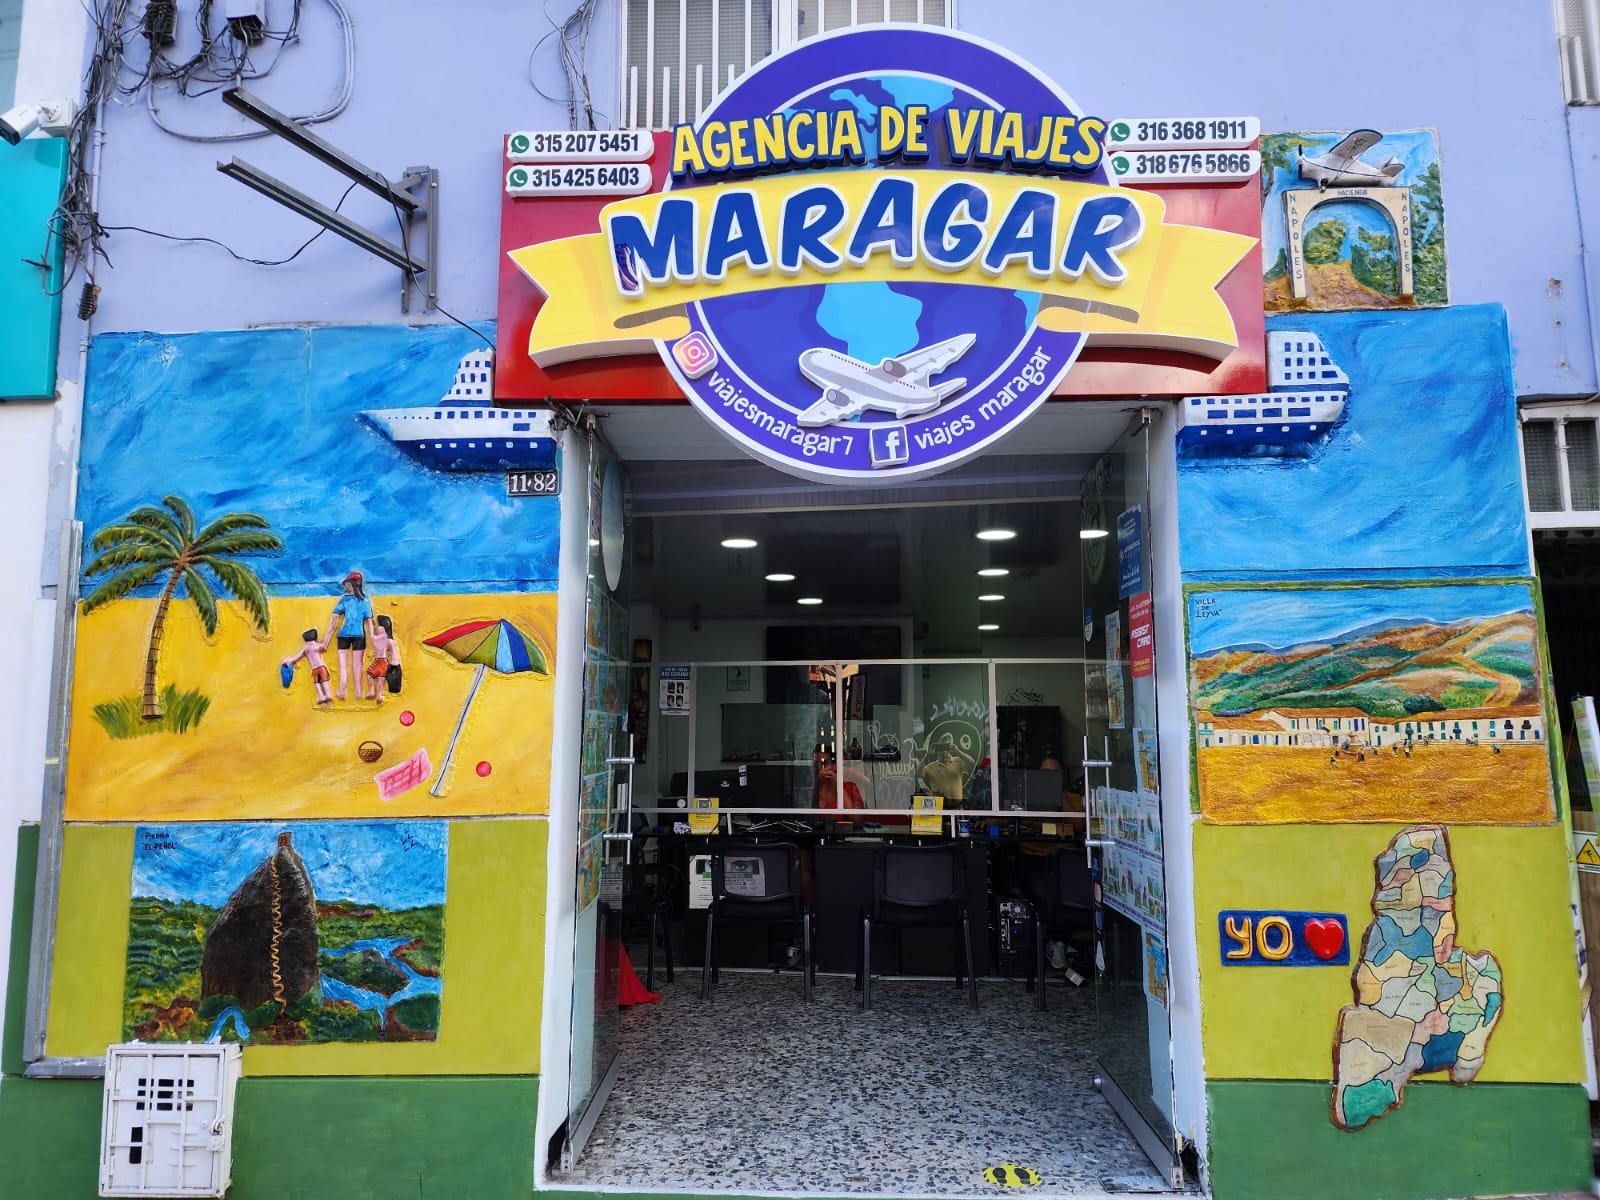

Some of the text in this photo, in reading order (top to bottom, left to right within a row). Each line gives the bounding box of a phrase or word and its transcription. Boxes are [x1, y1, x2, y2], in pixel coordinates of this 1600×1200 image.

[534, 133, 639, 152] 315 207 5451
[671, 105, 1106, 175] AGENCIA DE VIAJES
[1137, 120, 1246, 141] 316 368 1911
[532, 167, 641, 187] 315 425 6403
[1136, 154, 1251, 174] 318 676 5866
[608, 178, 1143, 297] MARAGAR
[707, 370, 853, 457] viajesmaragar7
[913, 345, 1053, 450] viajes maragar
[1225, 916, 1294, 960] YO
